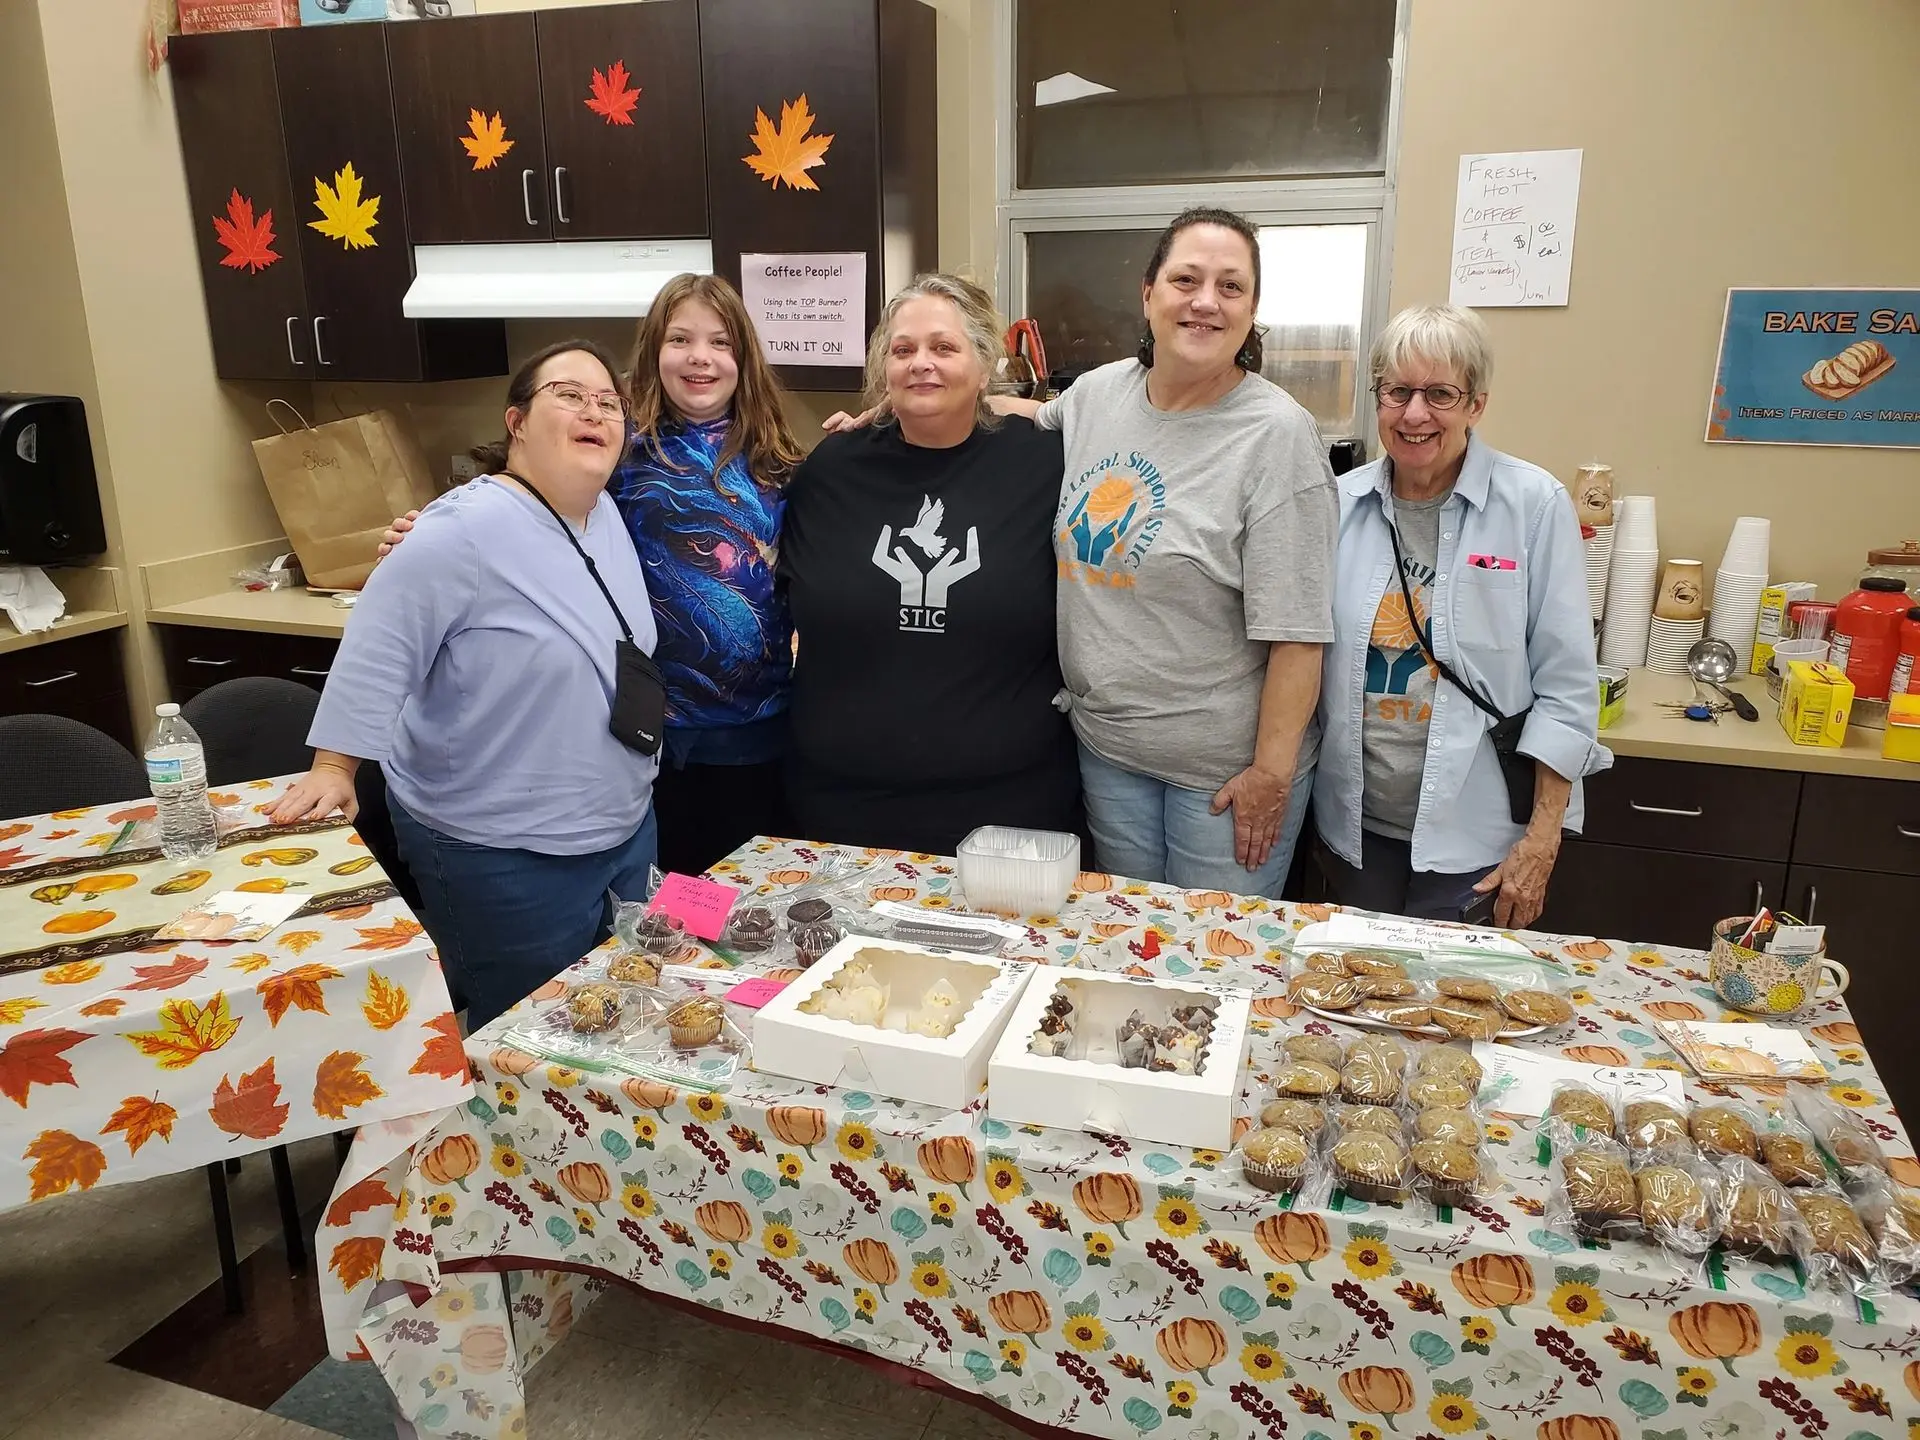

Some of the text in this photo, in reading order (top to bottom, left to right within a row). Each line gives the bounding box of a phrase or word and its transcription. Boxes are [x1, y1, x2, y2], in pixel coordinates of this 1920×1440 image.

[1483, 183, 1531, 198] HOT
[1462, 205, 1525, 224] COFFEE
[1456, 247, 1498, 261] TEA
[764, 265, 843, 280] Coffee People!
[763, 298, 848, 308] Using the TOP Burner?
[765, 312, 774, 320] It
[776, 312, 789, 320] has
[791, 312, 801, 320] its
[1763, 308, 1920, 334] BAKE SA
[768, 341, 843, 353] TURN IT ON!
[1739, 406, 1785, 419] ITEMS
[1790, 407, 1848, 420] PRICED
[1852, 410, 1873, 421] AS
[1124, 450, 1166, 512] Support
[1124, 517, 1163, 570] STIC
[899, 607, 946, 628] STIC
